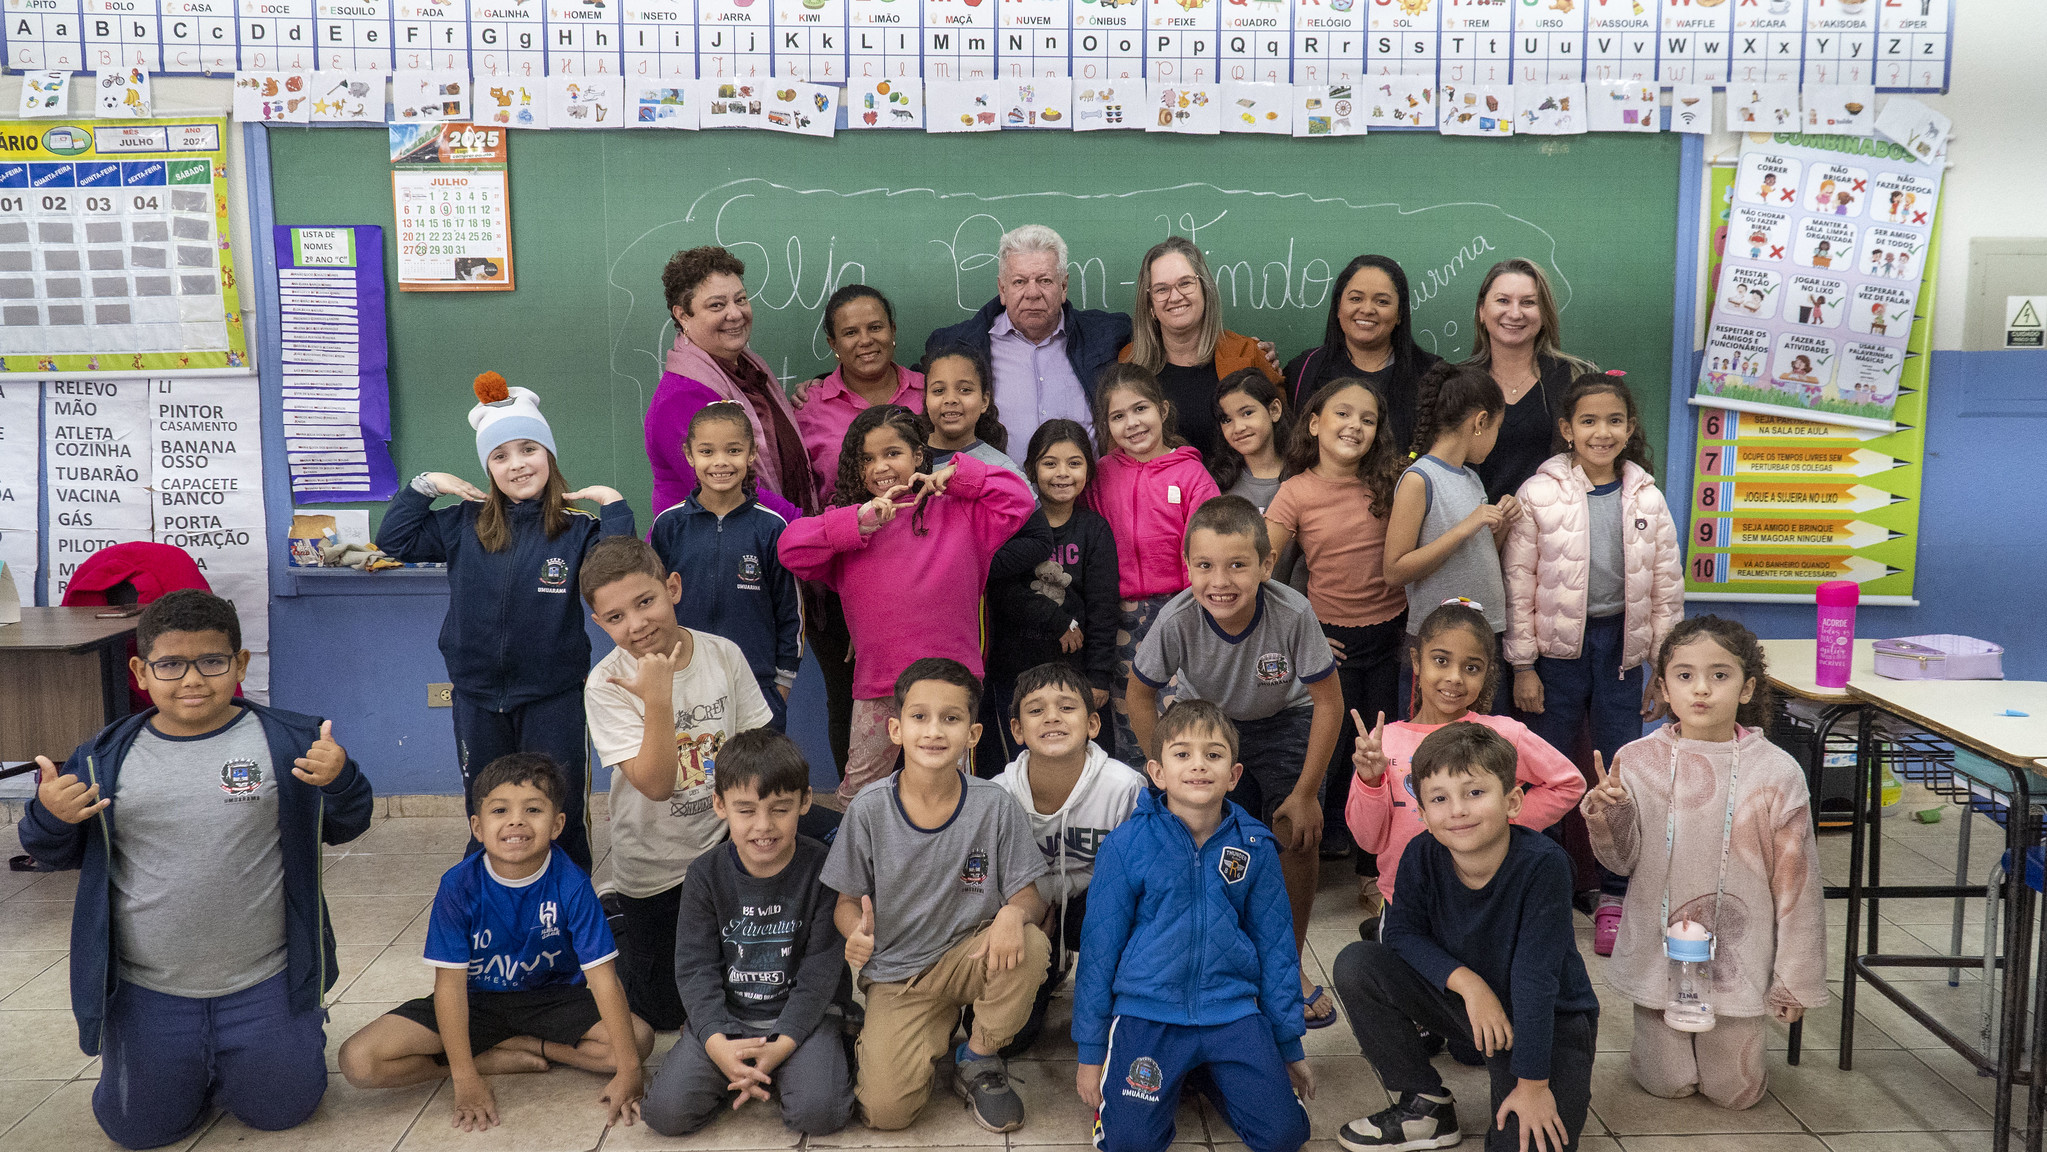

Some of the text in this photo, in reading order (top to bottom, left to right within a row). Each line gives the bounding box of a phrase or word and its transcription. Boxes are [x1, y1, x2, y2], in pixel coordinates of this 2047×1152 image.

[25, 1, 57, 9] APITO
[105, 2, 134, 10] BOLO
[183, 4, 212, 12] CASA
[261, 5, 290, 14] DOCE
[330, 7, 375, 16] ESQUILO
[416, 8, 444, 17] FADA
[484, 10, 529, 18] GALINHA
[564, 11, 602, 19] HOMEM
[640, 12, 677, 20] INSETO
[717, 13, 751, 21] JARRA
[799, 14, 820, 22] KIWI
[869, 13, 900, 23] LIMÃO
[945, 14, 973, 25] MAÇÃ
[1016, 16, 1051, 25] NUVEM
[1089, 15, 1127, 25] ÔNIBUS
[1168, 18, 1196, 26] PEIXE
[1234, 18, 1277, 27] QUADRO
[1307, 16, 1352, 27] RELÓGIO
[1393, 19, 1413, 28] SOL
[1463, 19, 1490, 28] TREM
[1536, 19, 1563, 28] URSO
[1596, 19, 1649, 28] VASSOURA
[17, 19, 67, 36] A a
[1676, 20, 1715, 28] WAFFLE
[1818, 20, 1867, 28] YAKISOBA
[251, 24, 300, 40] D d
[559, 29, 607, 45] H h
[482, 28, 531, 48] G g
[934, 34, 985, 50] M m
[1305, 38, 1350, 53] R r
[1669, 39, 1719, 53] W w
[119, 138, 153, 147] JULHO
[448, 131, 499, 147] 2025
[1765, 156, 1783, 165] NÃO
[127, 163, 162, 184] SEXTA-FEIRA
[175, 164, 205, 181] SÁBADO
[1757, 164, 1788, 173] CORRER
[1830, 166, 1848, 174] NÃO
[33, 164, 72, 187] QUARTA-FEIRA
[79, 164, 118, 186] QUINTA-FEIRA
[1823, 173, 1852, 183] BRIGAR
[1897, 175, 1915, 183] NÃO
[431, 178, 468, 186] JULHO
[1876, 181, 1932, 195] FAZER FOFOCA
[1, 196, 158, 212] 01 02 03 04
[455, 206, 465, 215] 10
[481, 206, 490, 215] 12
[402, 219, 412, 228] 13
[415, 219, 425, 228] 14
[442, 219, 452, 228] 16
[455, 219, 465, 228] 17
[468, 219, 478, 228] 18
[481, 219, 491, 228] 19
[1409, 234, 1495, 312] urma
[1735, 269, 1768, 278] PRESTAR
[1733, 275, 1769, 287] ATENÇÃO
[1794, 277, 1840, 288] JOGAR LIXO
[1815, 287, 1834, 295] LIXO
[1865, 286, 1897, 295] ESPERAR
[1886, 296, 1910, 305] FALAR
[1791, 336, 1813, 344] FAZER
[1784, 343, 1829, 354] ATIVIDADES
[55, 381, 117, 397] RELEVO
[54, 398, 97, 416] MÃO
[159, 405, 223, 419] PINTOR
[160, 421, 238, 432] CASAMENTO
[1706, 416, 1720, 435] 6
[1772, 427, 1792, 435] SALA
[1794, 427, 1805, 435] DE
[1807, 427, 1829, 435] AULA
[55, 426, 113, 440] ATLETA
[55, 443, 131, 458] COZINHA
[161, 440, 236, 453] BANANA
[161, 455, 208, 468] OSSO
[1705, 453, 1718, 471] 7
[56, 465, 139, 482] TUBARÃO
[161, 478, 238, 490] CAPACETE
[56, 489, 121, 503] VACINA
[162, 492, 225, 506] BANCO
[1702, 487, 1715, 506] 8
[1744, 492, 1838, 503] JOGUE A SUJEIRA NO LIXO
[58, 510, 92, 526] GÁS
[164, 516, 222, 529] PORTA
[1700, 523, 1712, 542] 9
[1743, 523, 1761, 531] SEJA
[1764, 524, 1790, 532] AMIGO
[1799, 524, 1834, 533] BRINQUE
[164, 530, 250, 549] CORAÇÃO
[1761, 534, 1795, 542] MAGOAR
[1797, 534, 1833, 543] NINGUÉM
[1048, 543, 1079, 566] IC
[1694, 559, 1714, 578] 10
[1823, 619, 1848, 627] ACORDE
[743, 905, 781, 916] BE WILD
[473, 929, 492, 950] 10
[469, 950, 562, 981] SAVVY
[1121, 1089, 1160, 1102] UMUARAMA
